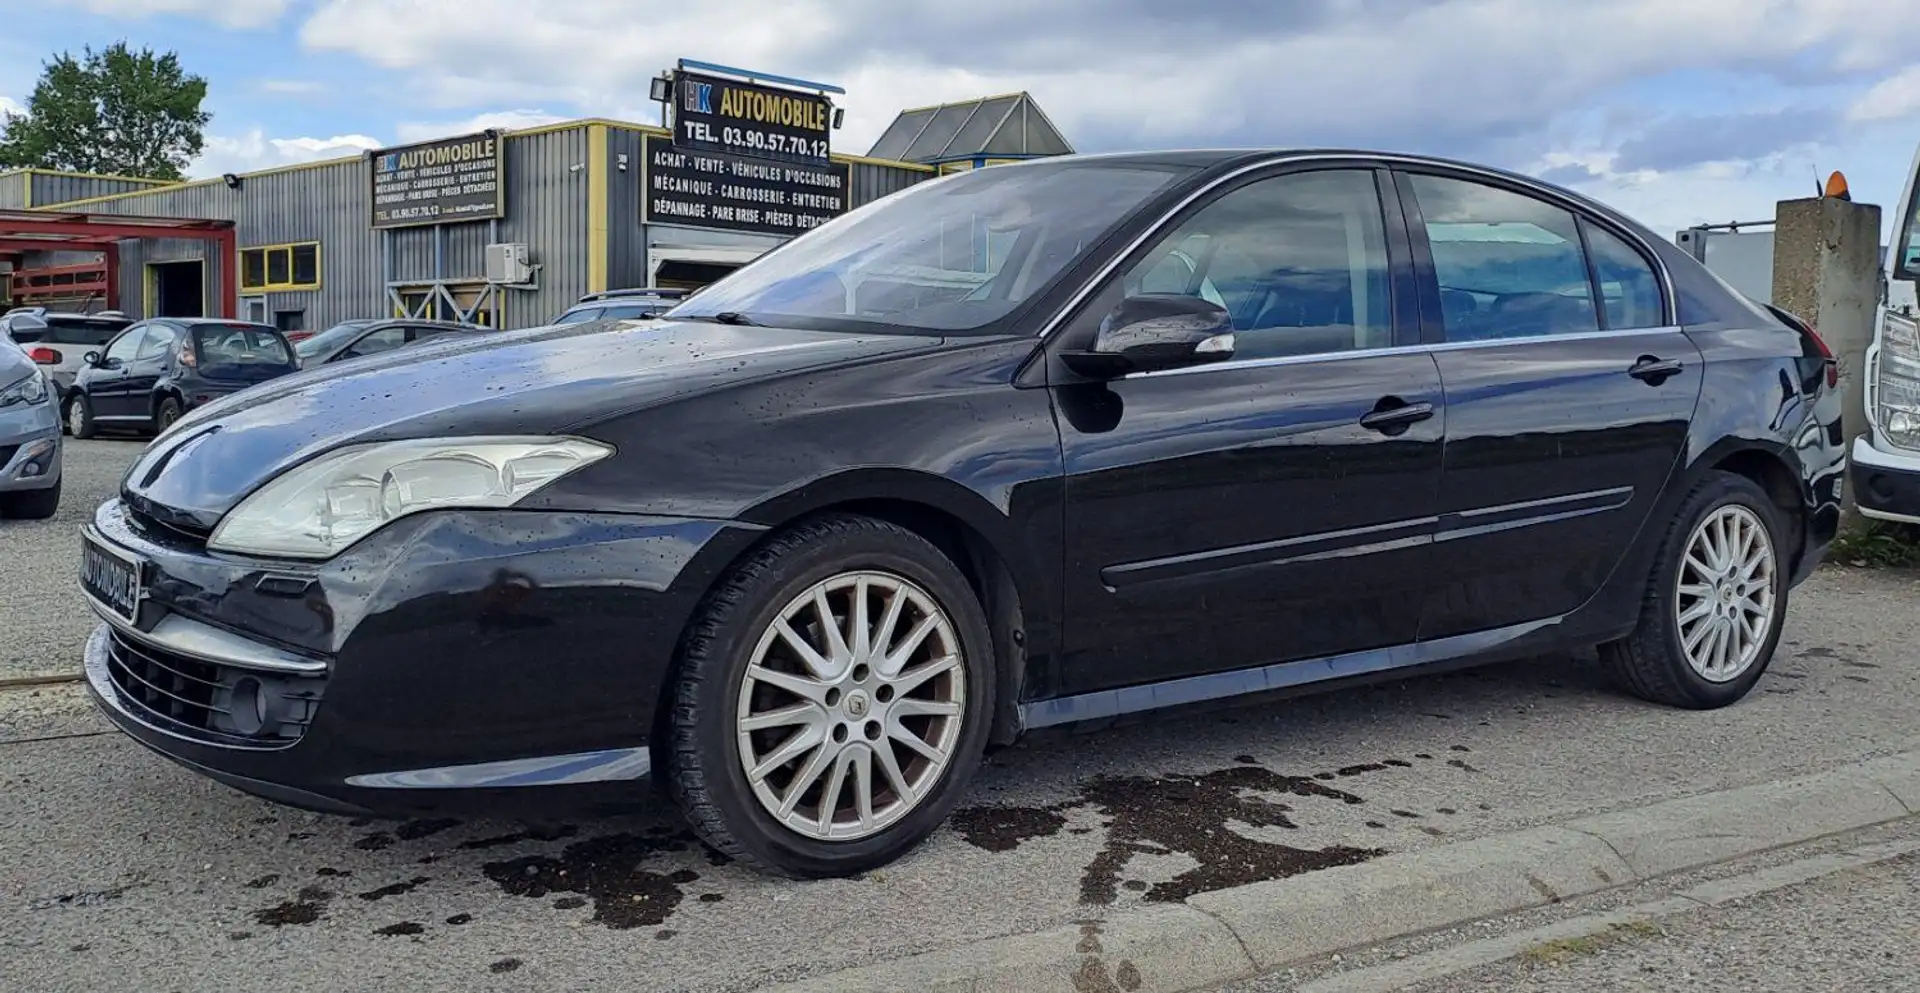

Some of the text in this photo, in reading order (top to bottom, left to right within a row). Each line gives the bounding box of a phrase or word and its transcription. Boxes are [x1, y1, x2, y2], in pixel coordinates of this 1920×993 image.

[684, 80, 825, 131] HK AUTOMOBILE
[399, 139, 495, 169] AUTOMOBILE
[684, 120, 828, 158] TEL. 03.90.57.70.12
[654, 151, 841, 188] ACHAT VENTE VÉHICULES D'OCCASIONS
[654, 172, 841, 210] MÉCANIQUE CARROSSERIE ENTRETIEN
[654, 196, 706, 218] DÉPANNAGE
[712, 205, 734, 221] PARE
[736, 208, 759, 223] BRISE
[765, 208, 793, 227] PIÈCES
